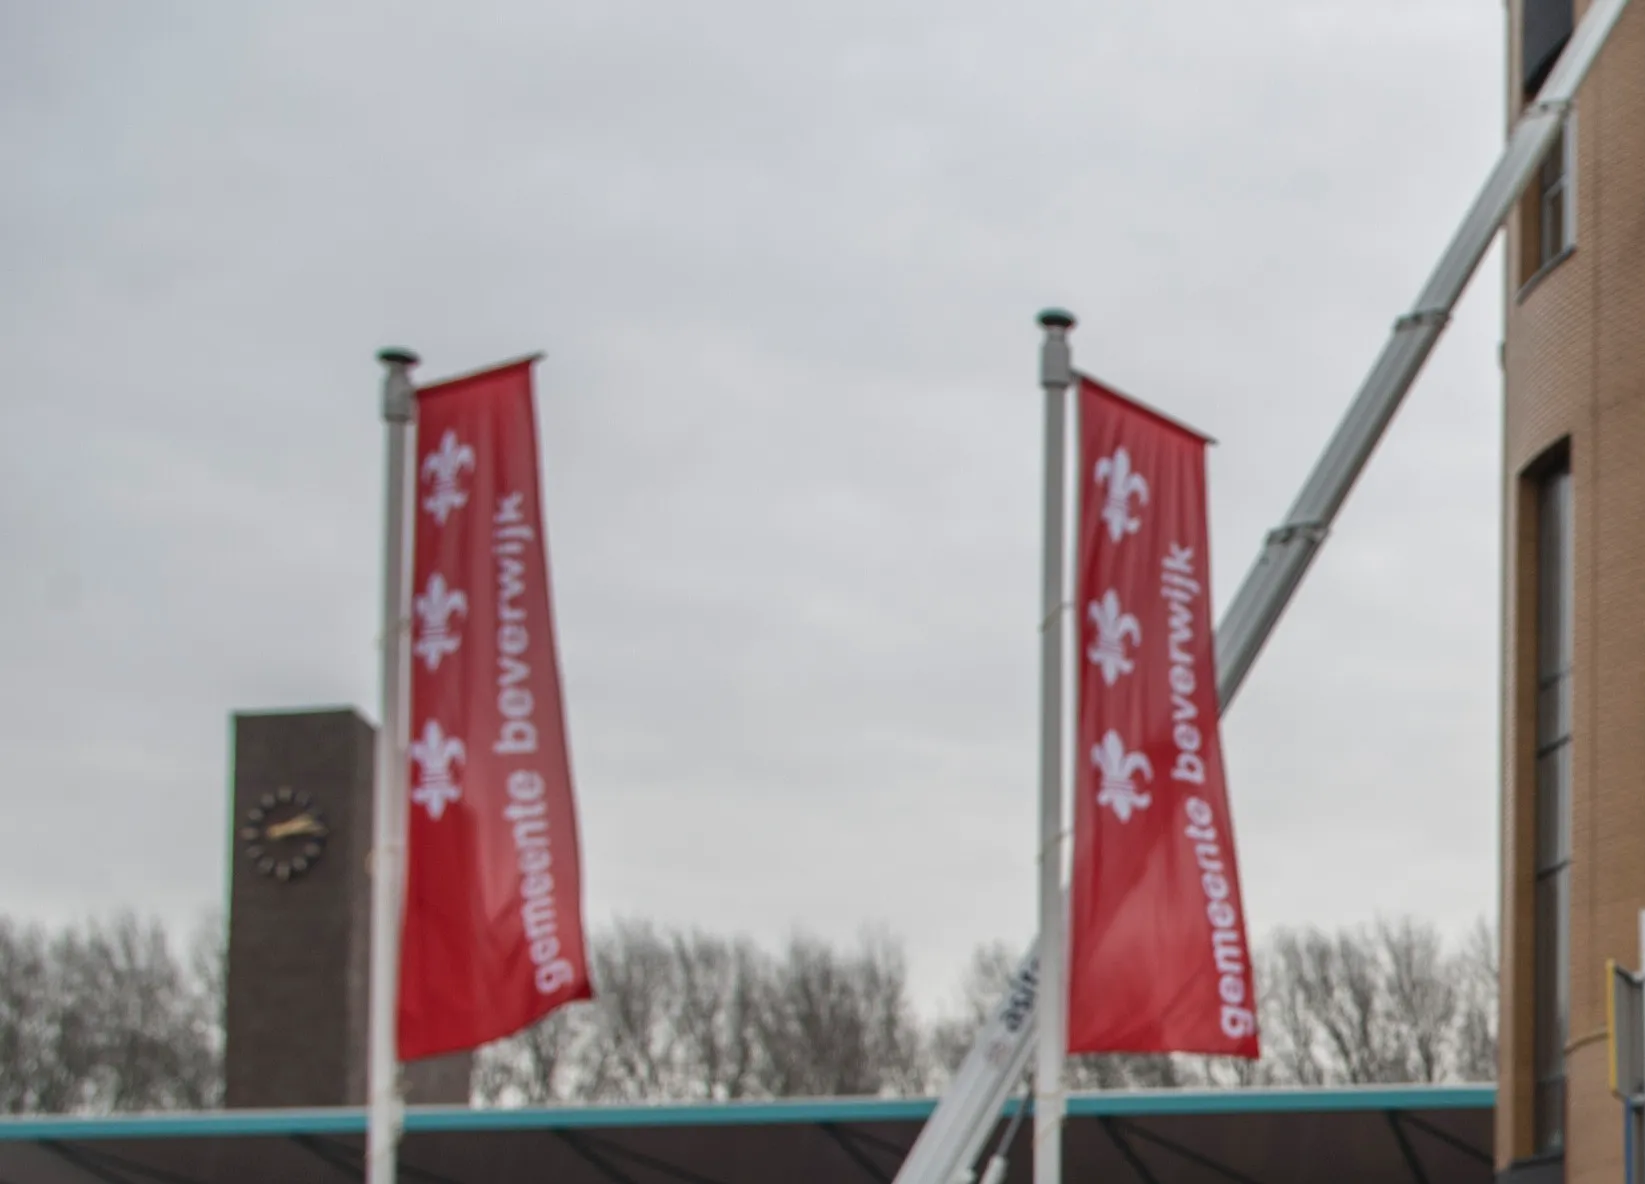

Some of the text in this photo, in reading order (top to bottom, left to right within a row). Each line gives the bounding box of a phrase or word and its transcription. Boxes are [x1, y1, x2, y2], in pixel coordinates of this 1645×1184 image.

[493, 491, 575, 994] gemeente beverwijk
[1160, 541, 1255, 1038] gemeente beverwijk
